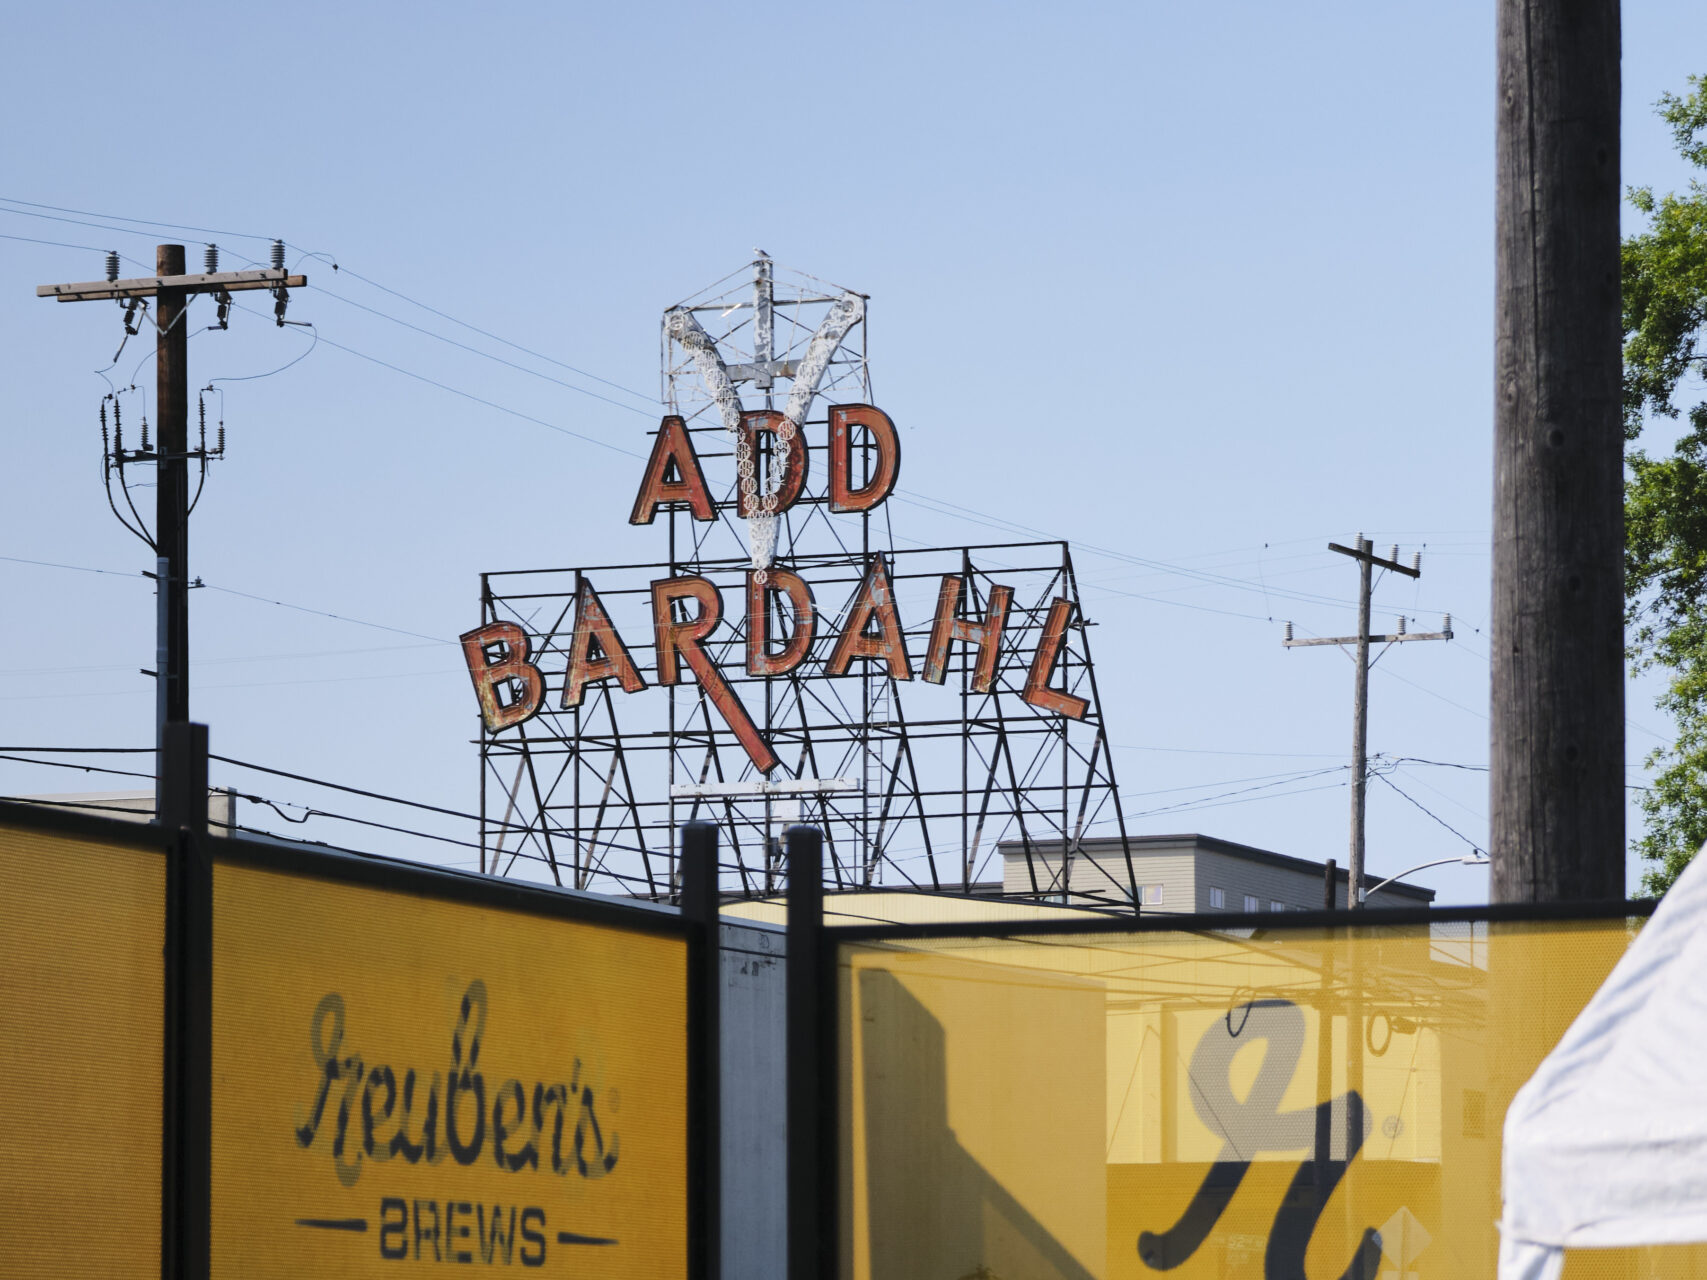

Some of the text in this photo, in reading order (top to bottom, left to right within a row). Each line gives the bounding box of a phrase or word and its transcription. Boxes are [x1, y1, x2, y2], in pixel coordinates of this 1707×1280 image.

[628, 402, 901, 526] ADD
[459, 550, 1091, 775] BARDAHL
[379, 1197, 547, 1268] BREWS
